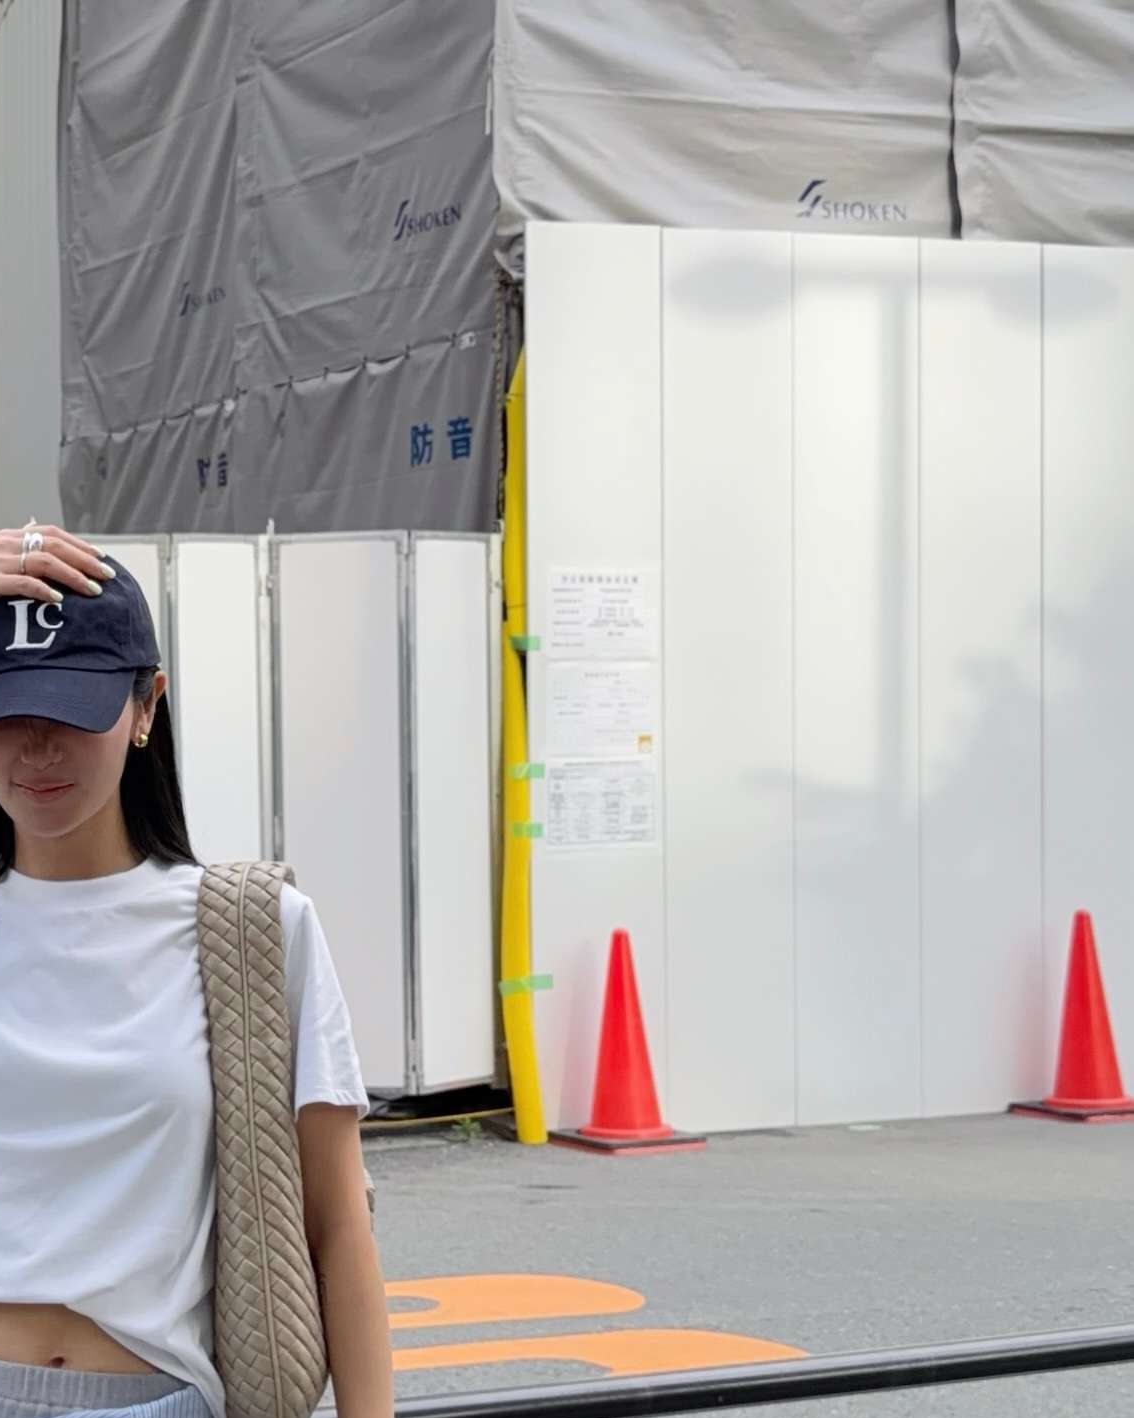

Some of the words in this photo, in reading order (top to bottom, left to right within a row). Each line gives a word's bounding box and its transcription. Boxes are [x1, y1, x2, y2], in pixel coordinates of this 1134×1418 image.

[407, 203, 462, 237] SHOKEN
[822, 200, 908, 221] SHOKEN
[410, 415, 473, 468] 防音
